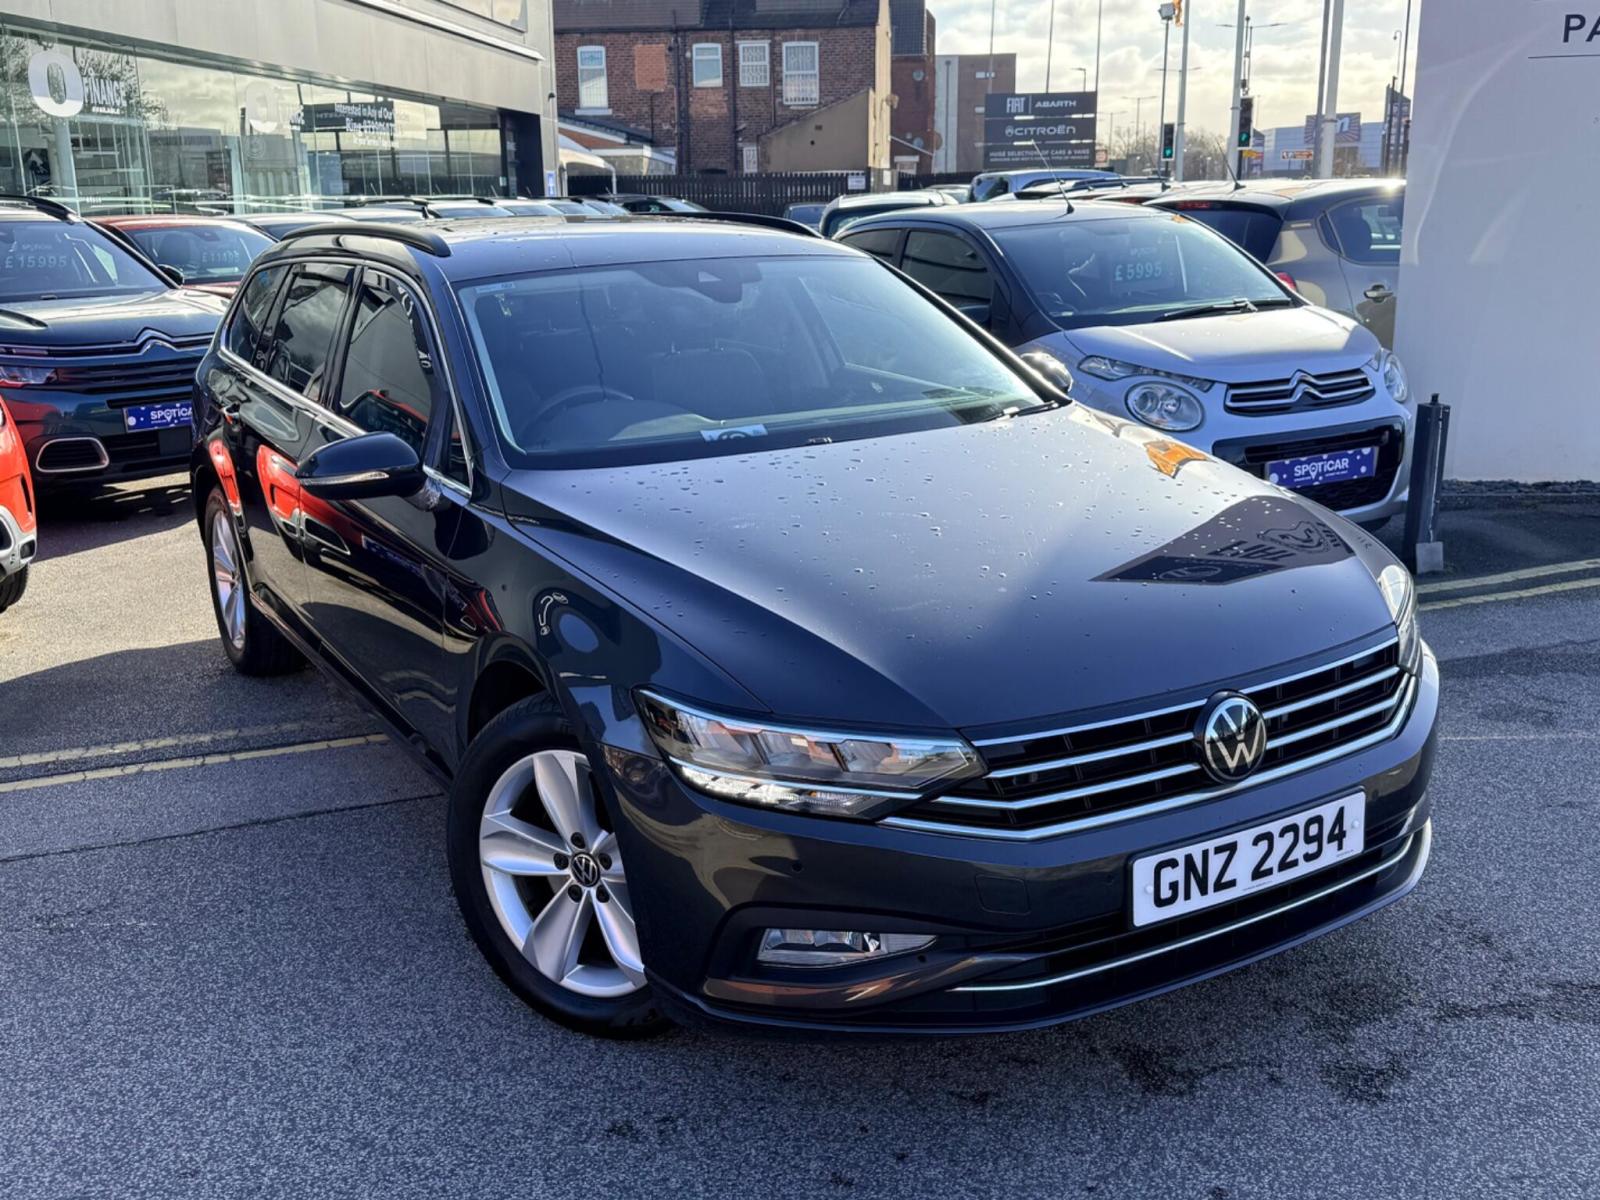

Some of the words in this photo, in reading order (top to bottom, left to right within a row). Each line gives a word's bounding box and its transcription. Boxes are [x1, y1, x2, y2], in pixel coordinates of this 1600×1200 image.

[1006, 97, 1026, 114] FIAT
[1035, 100, 1077, 109] ABARTH
[5, 255, 67, 269] £15995
[1114, 261, 1162, 281] £5995
[1153, 840, 1239, 909] GNZ
[1251, 806, 1348, 882] 2294
